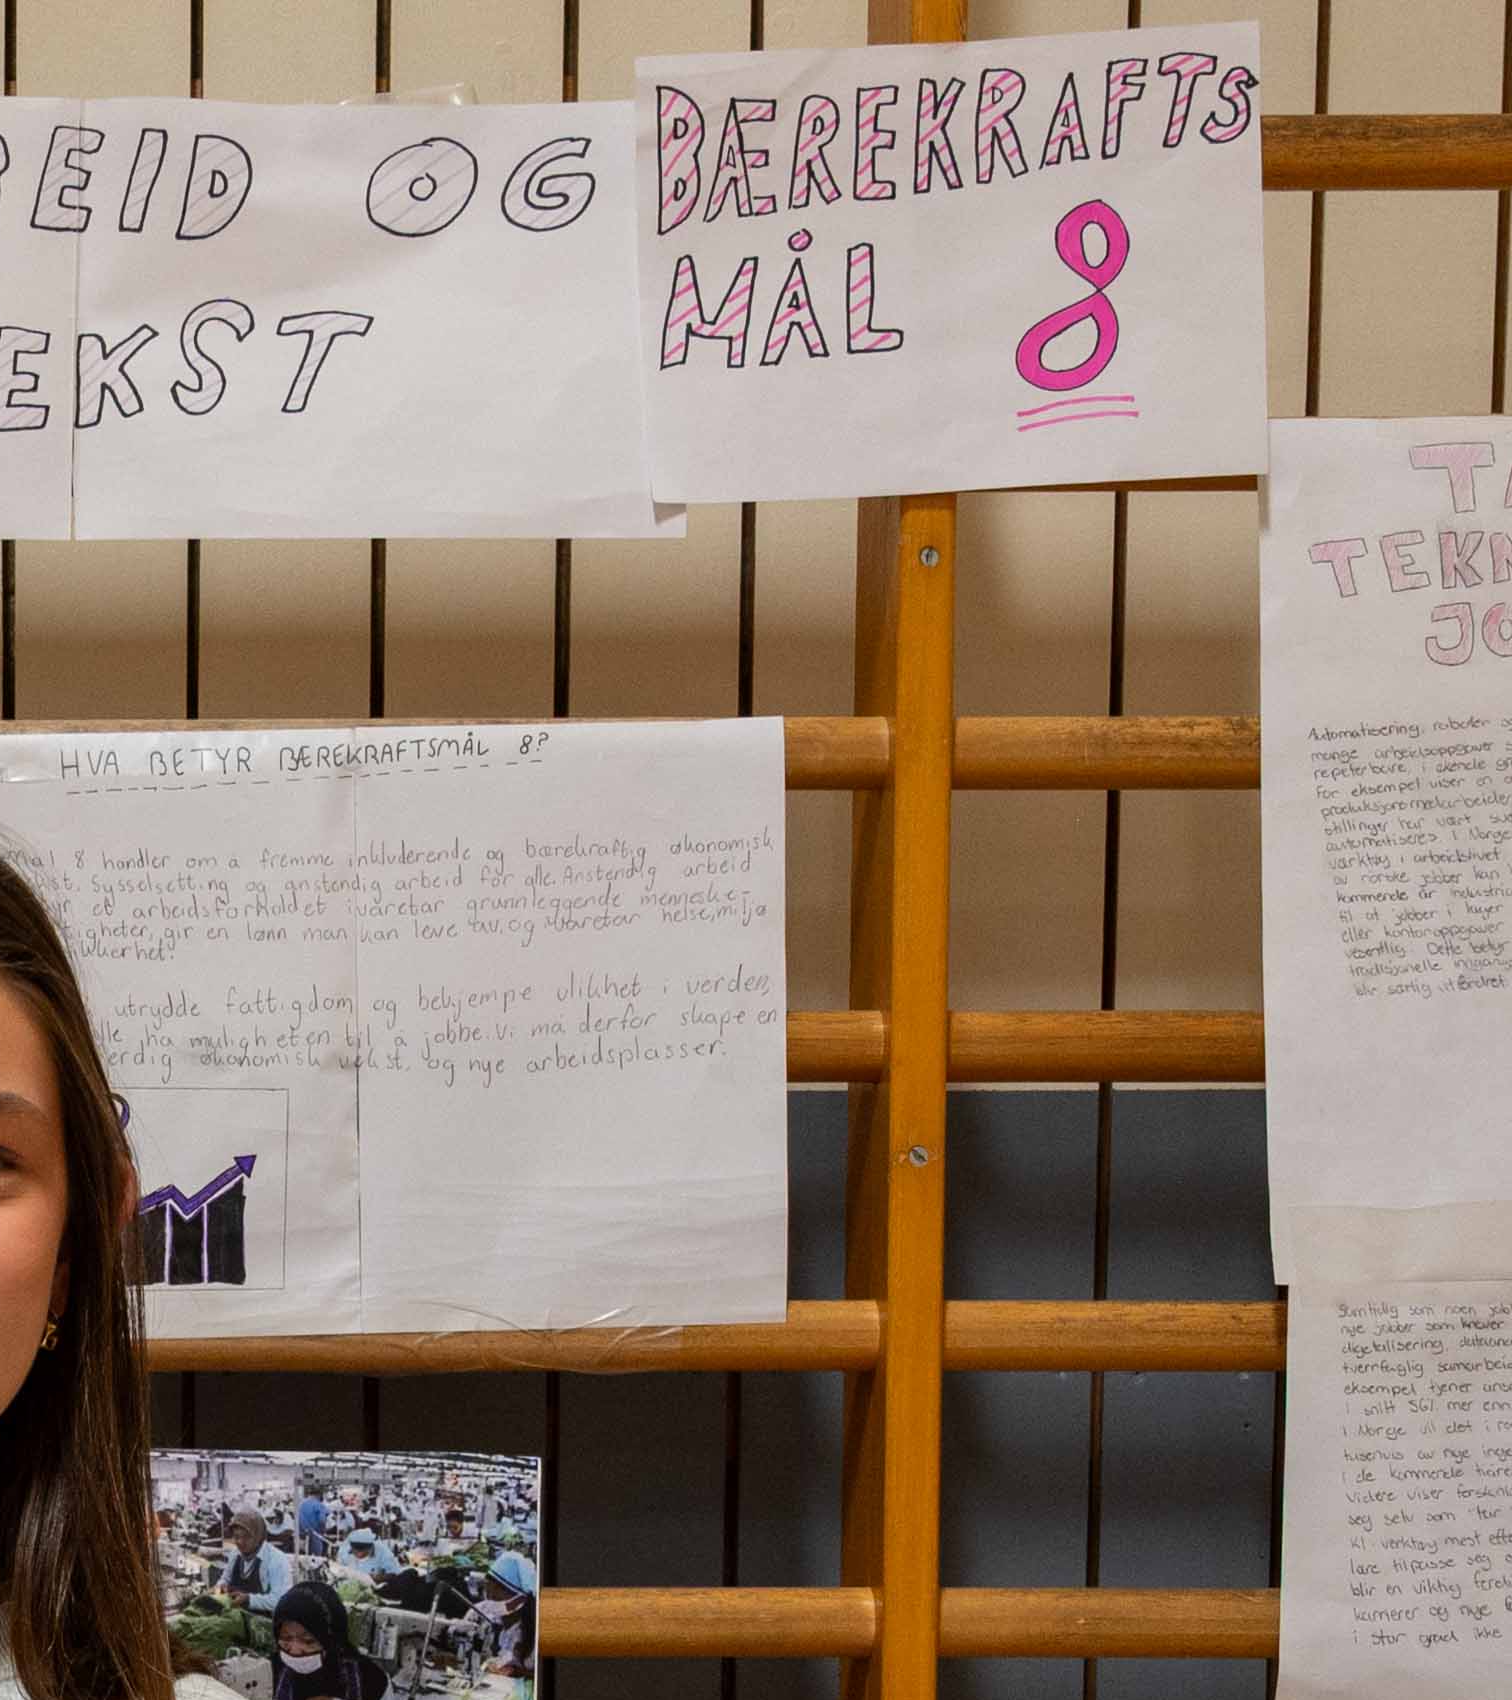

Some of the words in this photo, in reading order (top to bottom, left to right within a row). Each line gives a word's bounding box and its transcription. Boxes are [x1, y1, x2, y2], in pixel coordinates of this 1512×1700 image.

[366, 136, 597, 238] OG
[654, 51, 1261, 236] BÆREKRAFTS
[658, 229, 904, 370] MÅL
[1014, 197, 1132, 394] 8
[61, 751, 119, 779] HVA
[150, 746, 251, 776] BETYR
[279, 732, 489, 772] BÆREKRAFTSMÅL
[186, 857, 217, 868] om
